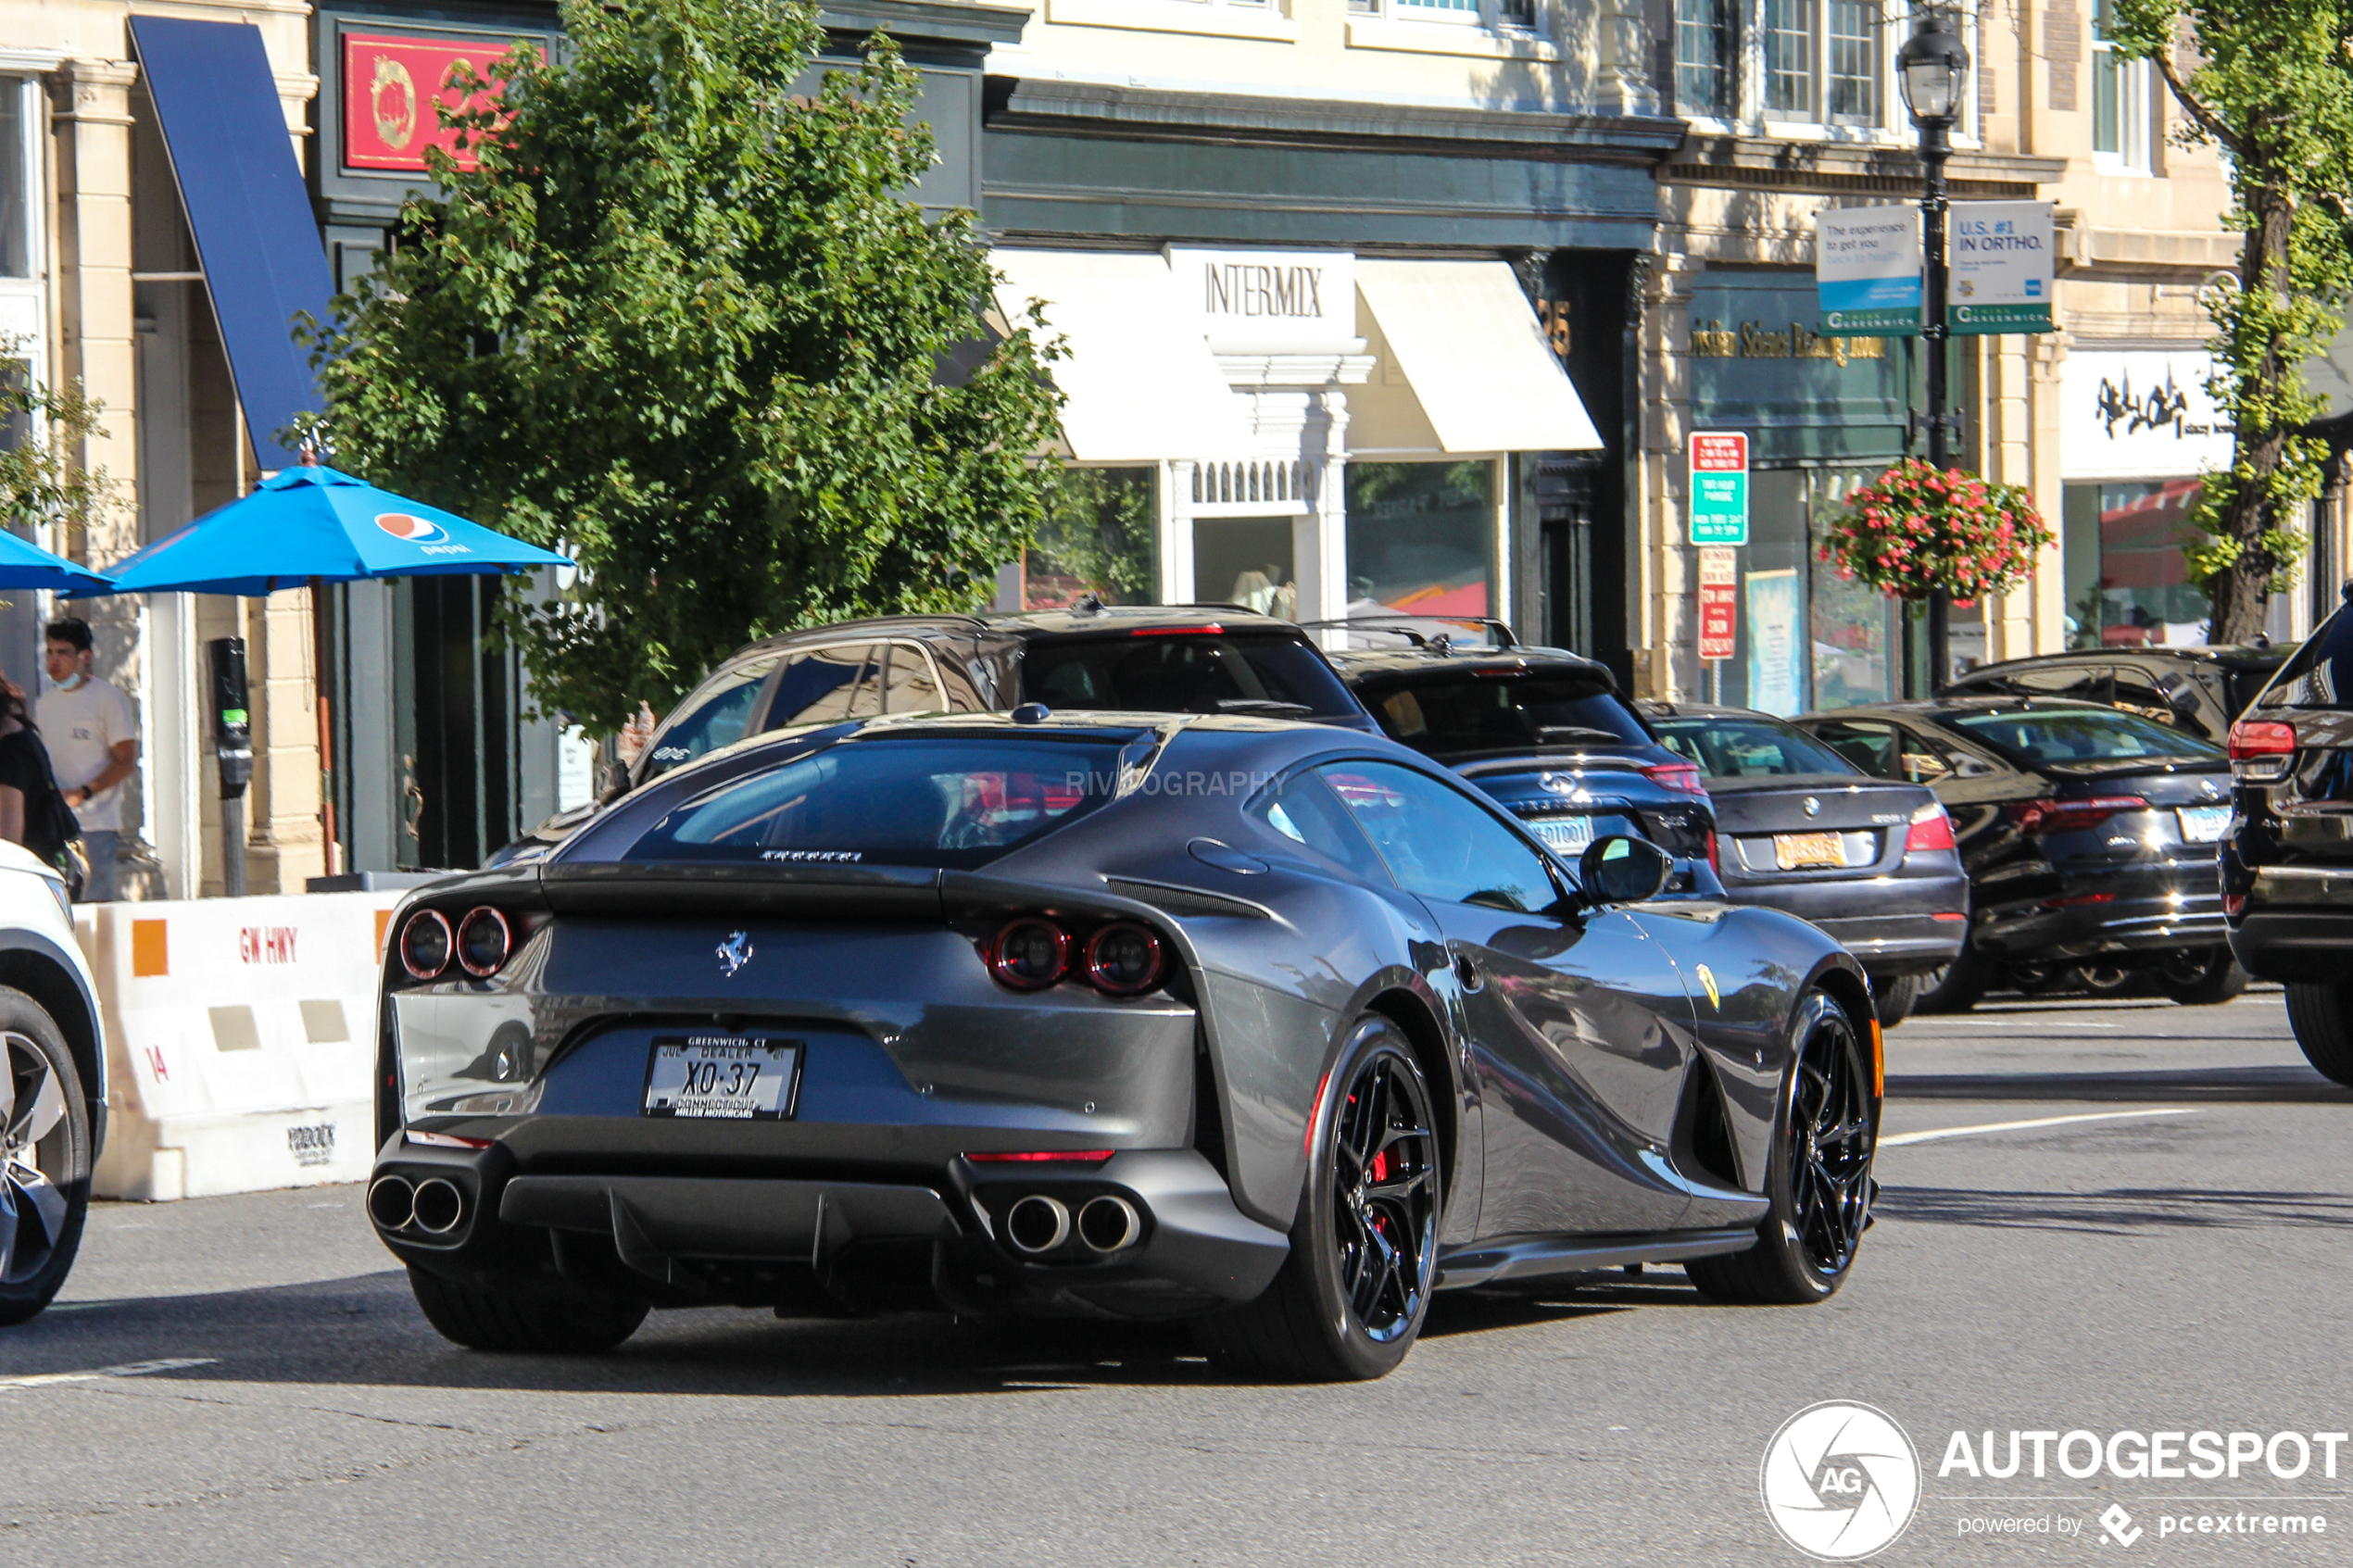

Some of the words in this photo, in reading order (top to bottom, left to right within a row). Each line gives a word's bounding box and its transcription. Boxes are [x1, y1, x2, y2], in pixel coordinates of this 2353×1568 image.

[1826, 225, 1846, 236] The
[1849, 222, 1906, 237] experience
[1958, 220, 1990, 236] U.S.
[1994, 220, 2014, 235] #1
[1826, 241, 1837, 251] to
[1839, 240, 1856, 252] get
[1859, 239, 1880, 251] you
[1958, 236, 1976, 251] IN
[1205, 262, 1324, 317] INTERMIX
[420, 544, 475, 556] pepsi
[239, 926, 260, 963] GW
[265, 926, 298, 963] HWY
[754, 1038, 767, 1047] CT
[661, 1047, 681, 1058] JUL
[700, 1047, 752, 1059] DEALER
[676, 1098, 757, 1110] CONNECTICUT
[674, 1108, 704, 1118] MILLER
[704, 1109, 753, 1119] MOTORCARS
